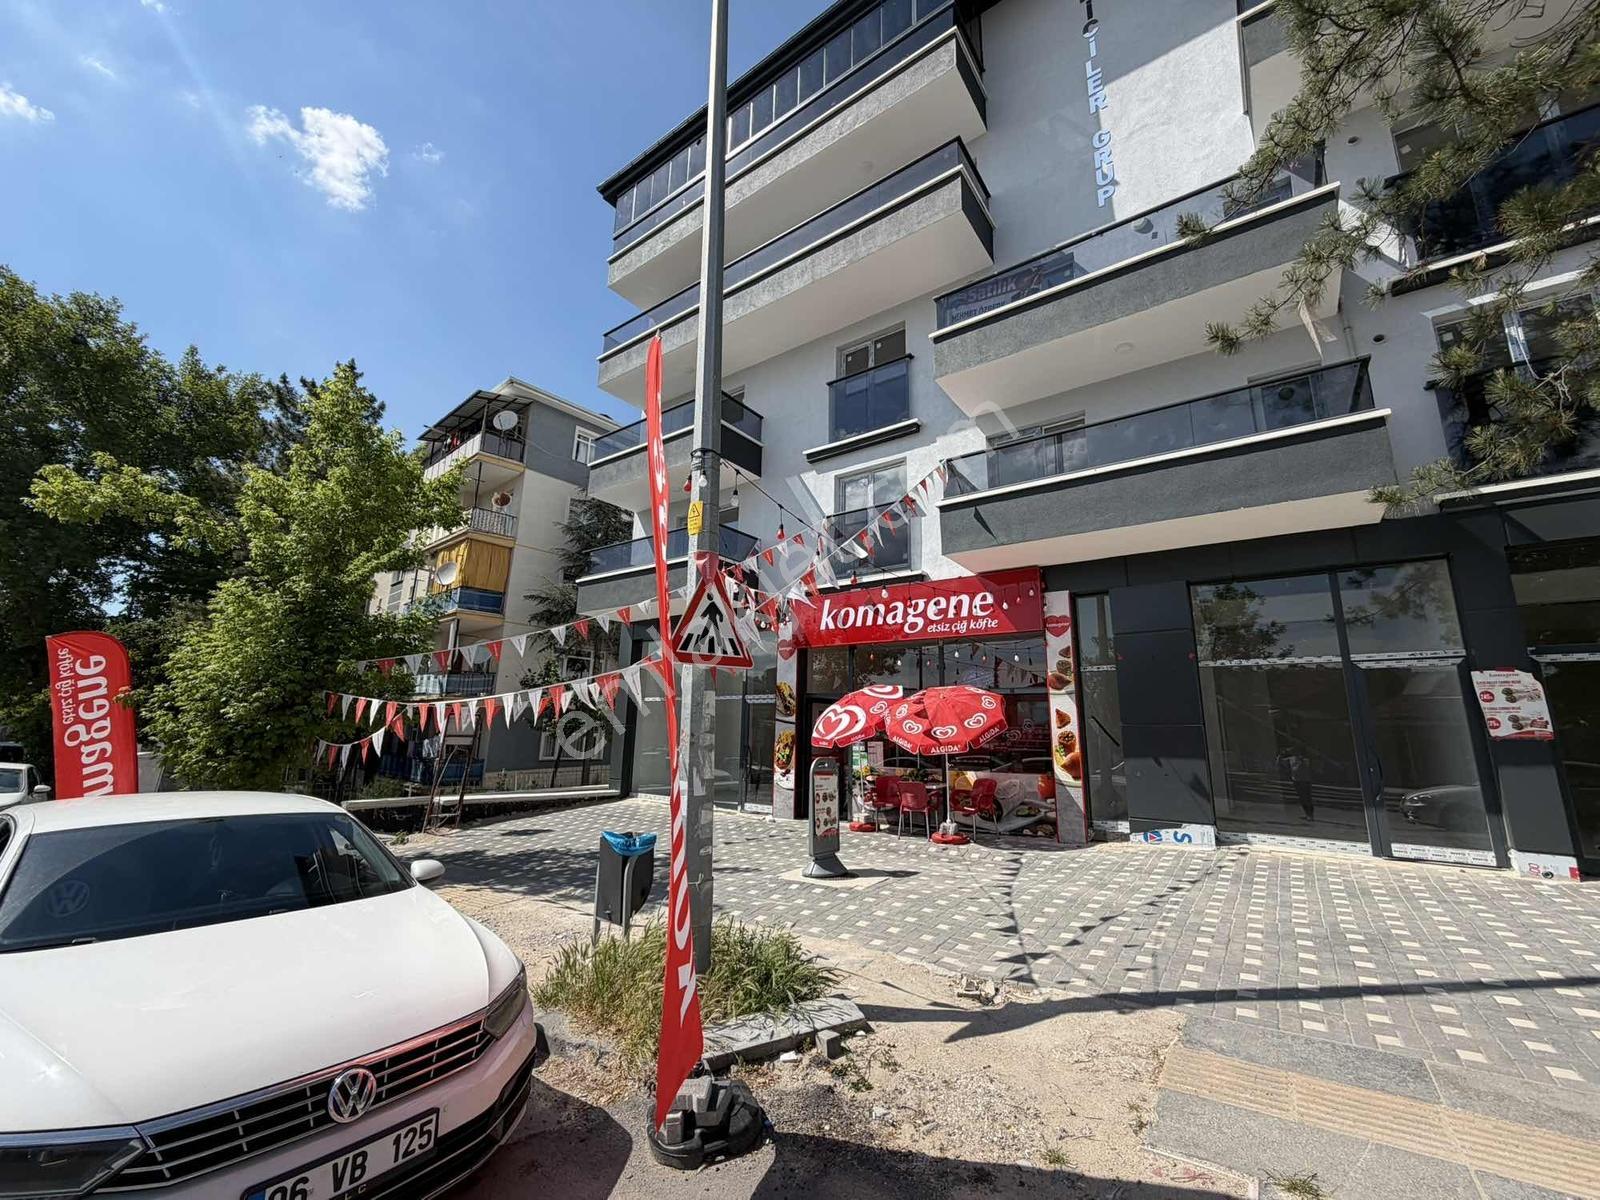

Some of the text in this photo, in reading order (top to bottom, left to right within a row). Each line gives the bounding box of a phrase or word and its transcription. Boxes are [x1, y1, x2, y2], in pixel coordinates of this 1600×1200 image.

[1091, 127, 1117, 208] GRUP
[819, 591, 995, 634] komagene
[927, 617, 999, 634] etsiz çiğ köfte
[892, 735, 913, 751] ALGIDA
[979, 726, 1001, 744] ALGIDA
[930, 745, 960, 754] ALGIDA
[332, 1151, 368, 1193] VB
[392, 1119, 434, 1164] 125
